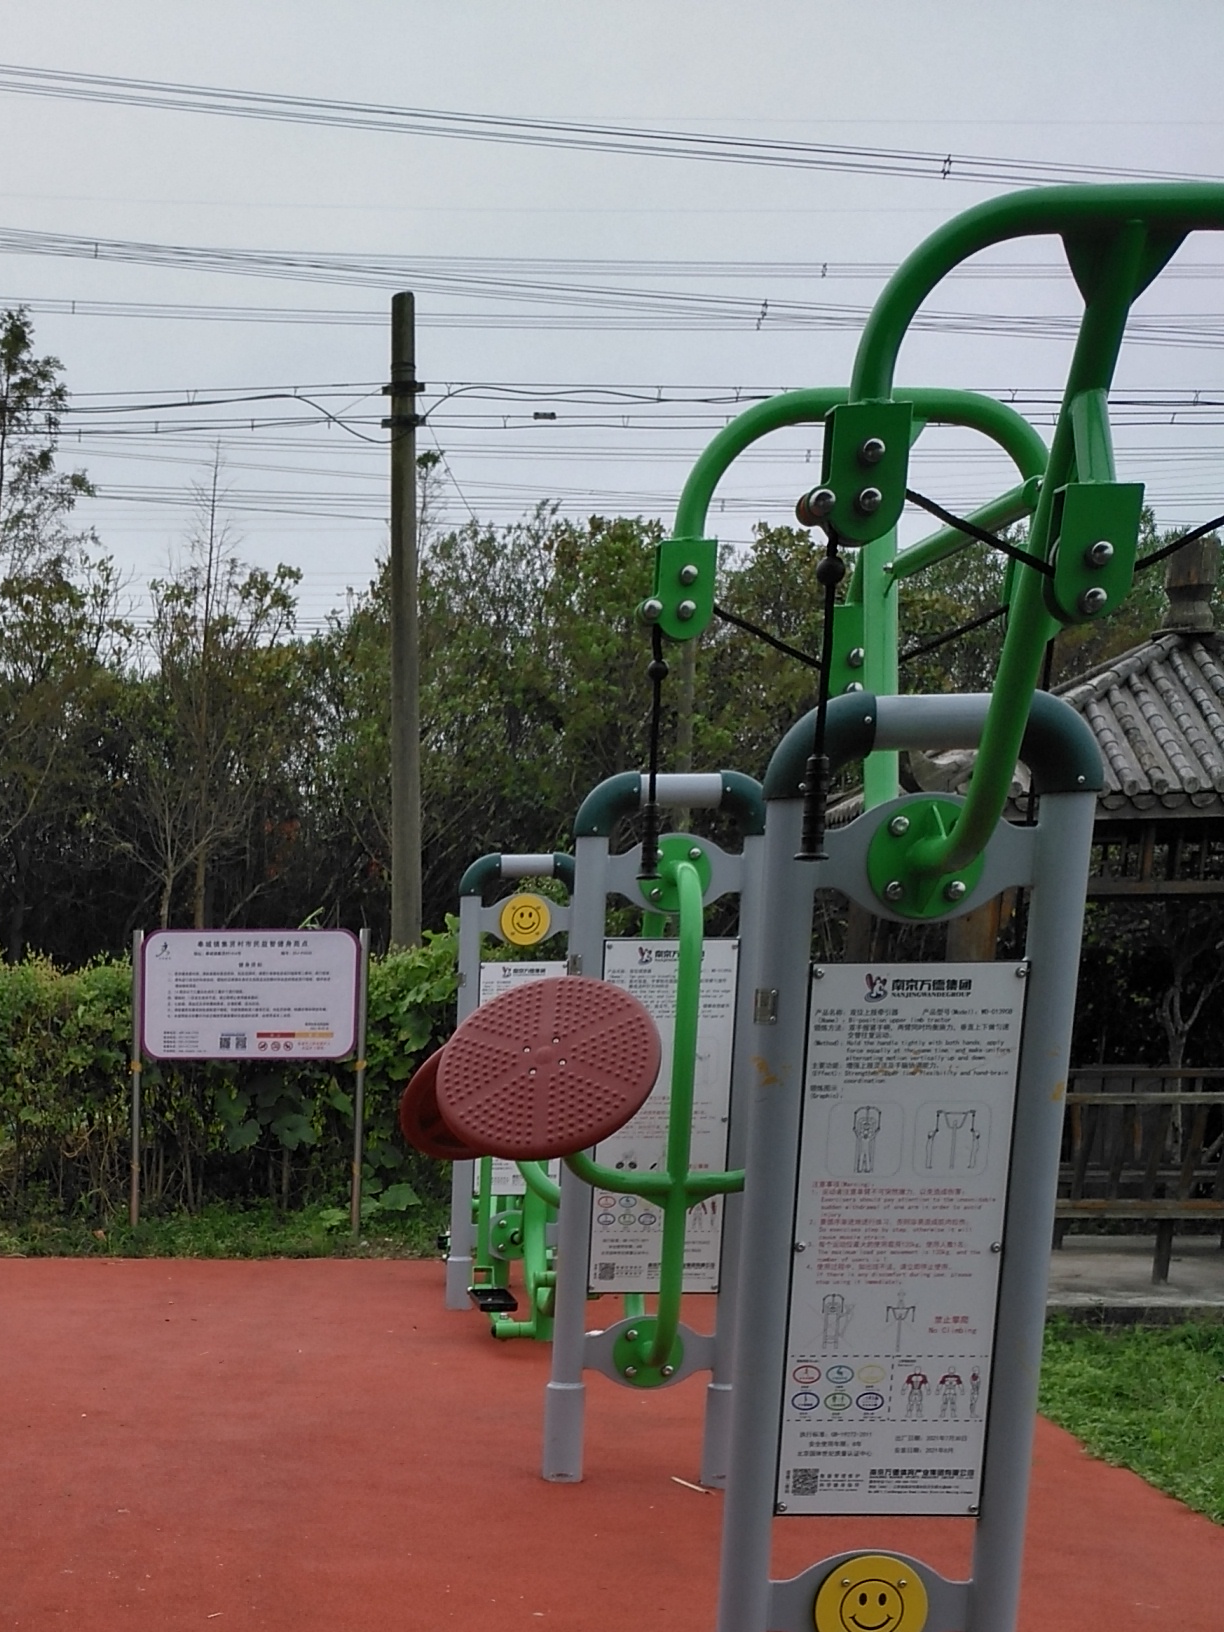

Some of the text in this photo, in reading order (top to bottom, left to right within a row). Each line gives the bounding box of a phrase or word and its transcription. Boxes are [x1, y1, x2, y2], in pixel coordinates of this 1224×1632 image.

[892, 979, 972, 991] 南京万德集团
